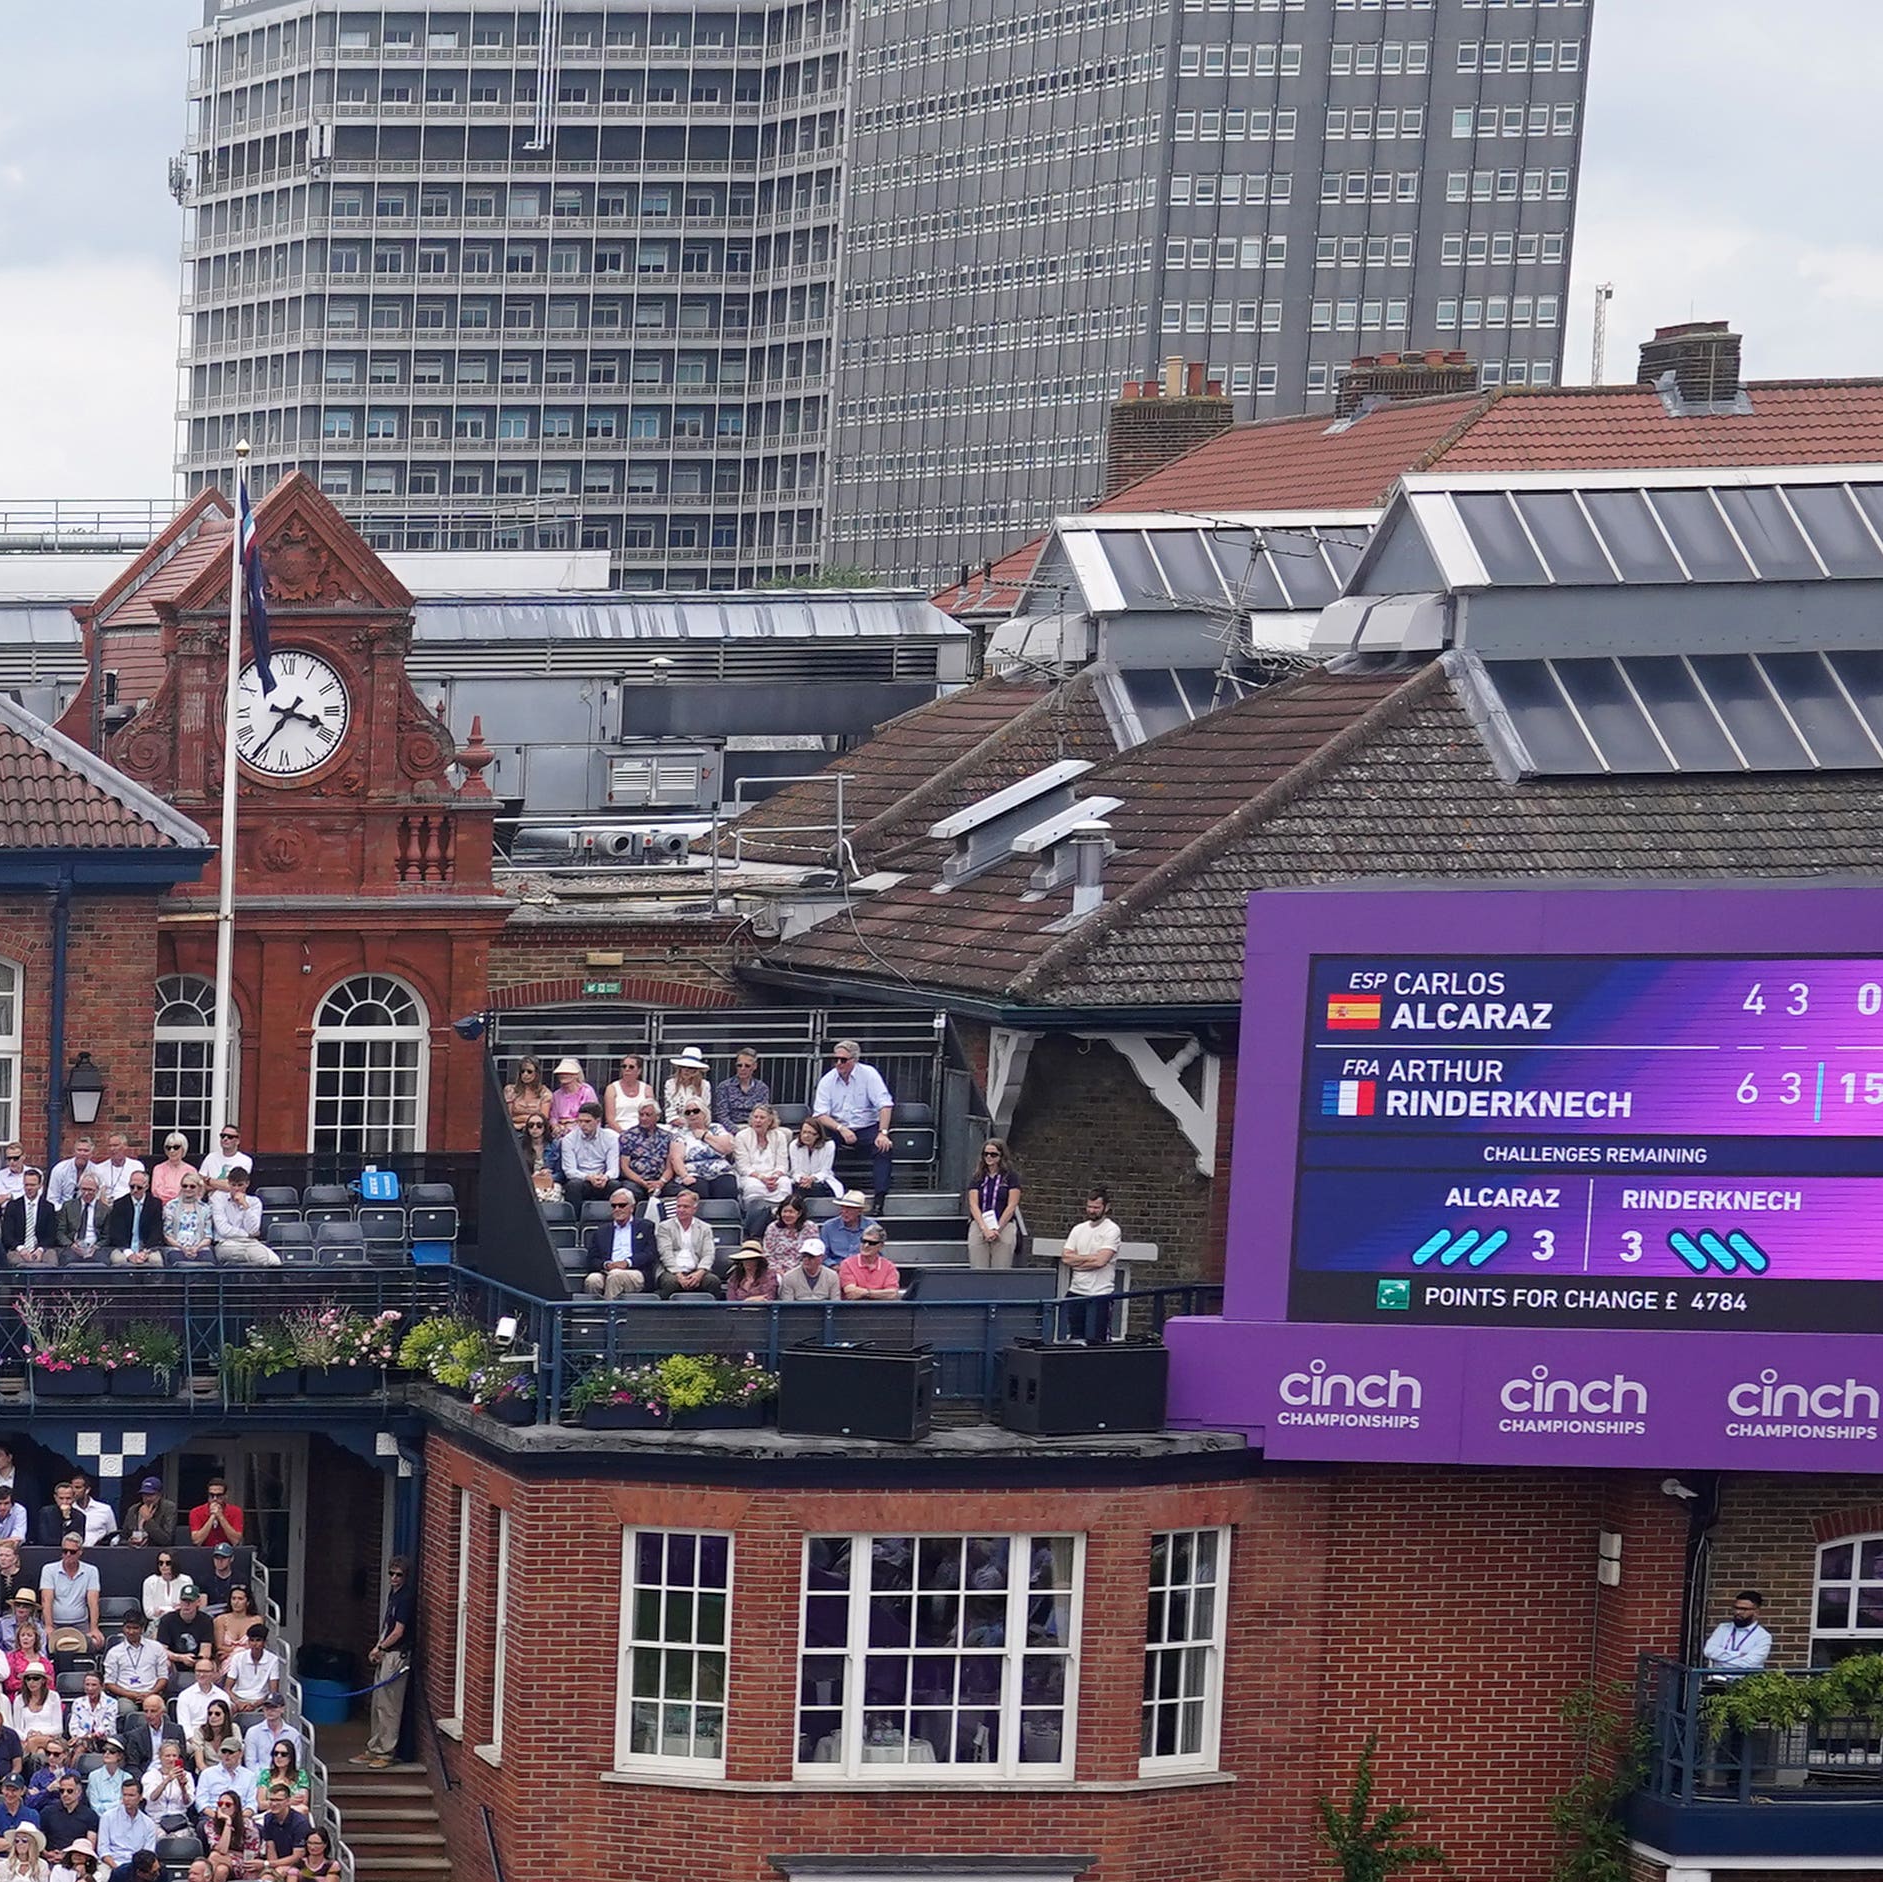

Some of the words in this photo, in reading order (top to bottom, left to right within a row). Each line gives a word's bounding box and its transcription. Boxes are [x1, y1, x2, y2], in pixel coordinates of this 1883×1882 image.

[281, 658, 296, 676] XII
[1349, 972, 1387, 989] ESP
[1394, 972, 1505, 995] CARLOS
[1743, 983, 1766, 1015] 4
[1786, 983, 1809, 1015] 3
[1857, 983, 1882, 1015] 0
[1390, 1003, 1553, 1030] ALCARAZ
[1342, 1059, 1380, 1076] FRA
[1387, 1059, 1503, 1082] ARTHUR
[1737, 1072, 1758, 1104] 6
[1779, 1072, 1802, 1104] 3
[1840, 1072, 1883, 1104] 15
[1386, 1090, 1632, 1119] RINDERKNECH
[1483, 1147, 1601, 1163] CHALLENGES
[1606, 1147, 1707, 1164] REMAINING
[1445, 1188, 1560, 1208] ALCARAZ
[1622, 1190, 1802, 1211] RINDERKNECH
[1532, 1230, 1555, 1261] 3
[1619, 1231, 1643, 1262] 3
[1425, 1287, 1505, 1307] POINTS
[1513, 1289, 1557, 1308] FOR
[1564, 1290, 1658, 1310] CHANGE
[1665, 1292, 1678, 1310] £
[1691, 1292, 1747, 1312] 4784
[1278, 1358, 1422, 1409] cinch
[1500, 1364, 1648, 1415] cinch
[1727, 1368, 1880, 1419] cinch
[1277, 1411, 1420, 1430] CHAMPIONSHIPS
[1498, 1418, 1646, 1435] CHAMPIONSHIPS
[1725, 1423, 1878, 1440] CHAMPIONSHIPS
